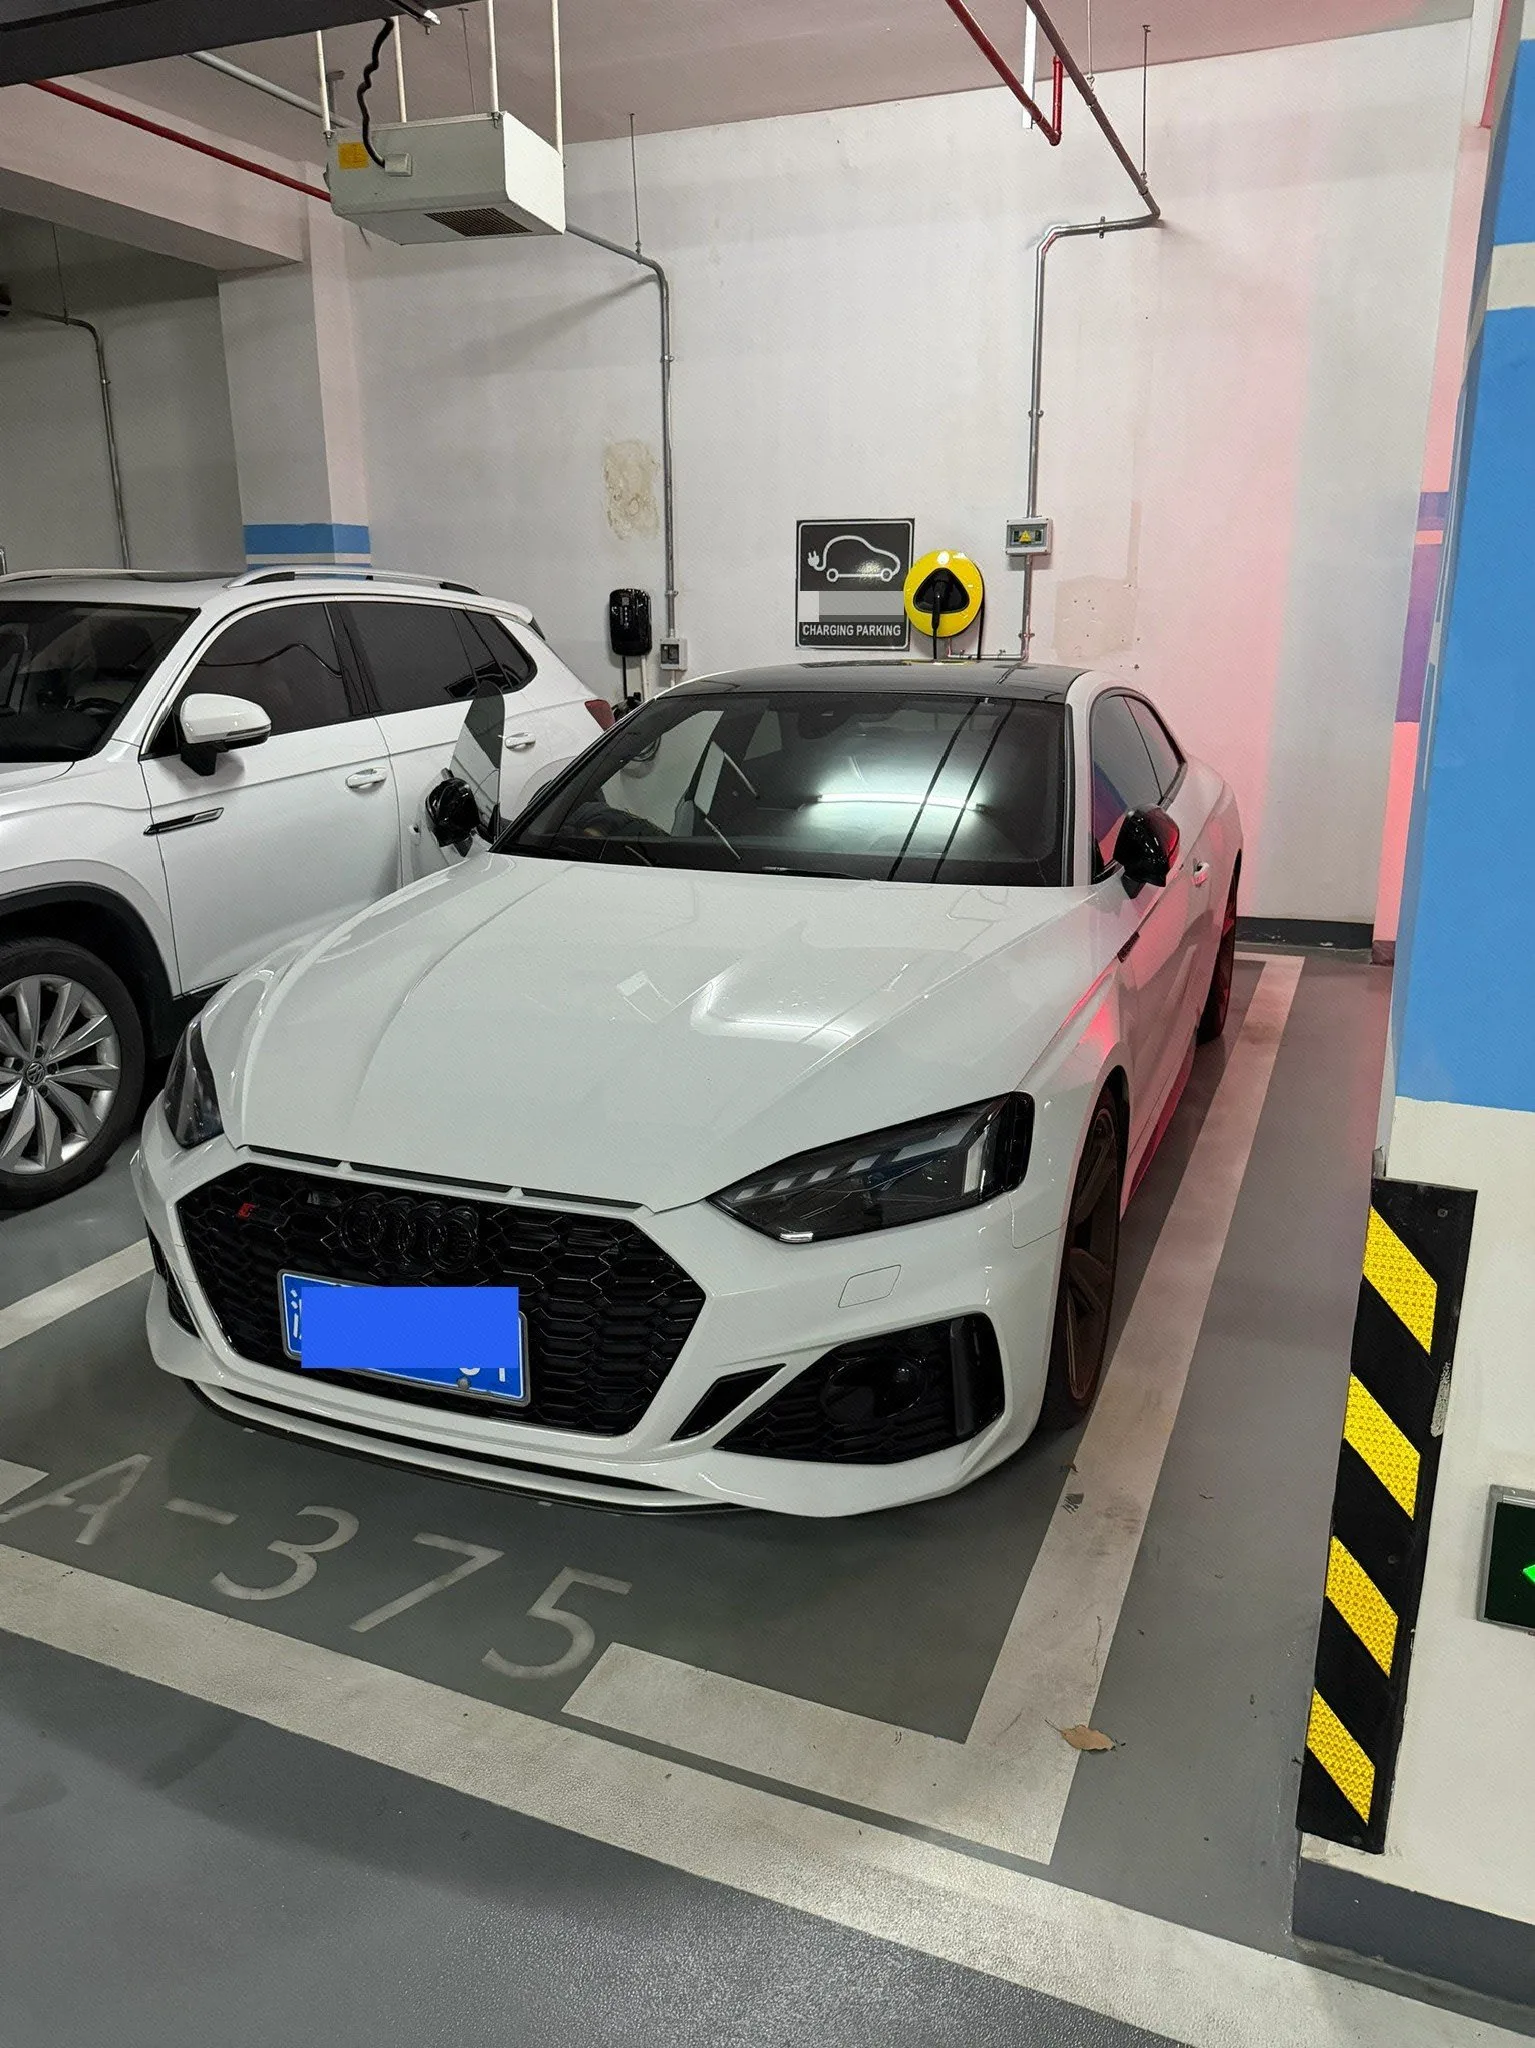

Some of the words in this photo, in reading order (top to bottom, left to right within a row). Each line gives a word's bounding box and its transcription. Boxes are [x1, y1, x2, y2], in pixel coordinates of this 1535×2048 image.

[802, 624, 854, 636] CHARGING
[856, 625, 901, 636] PARKING
[0, 1454, 632, 1678] A-375
